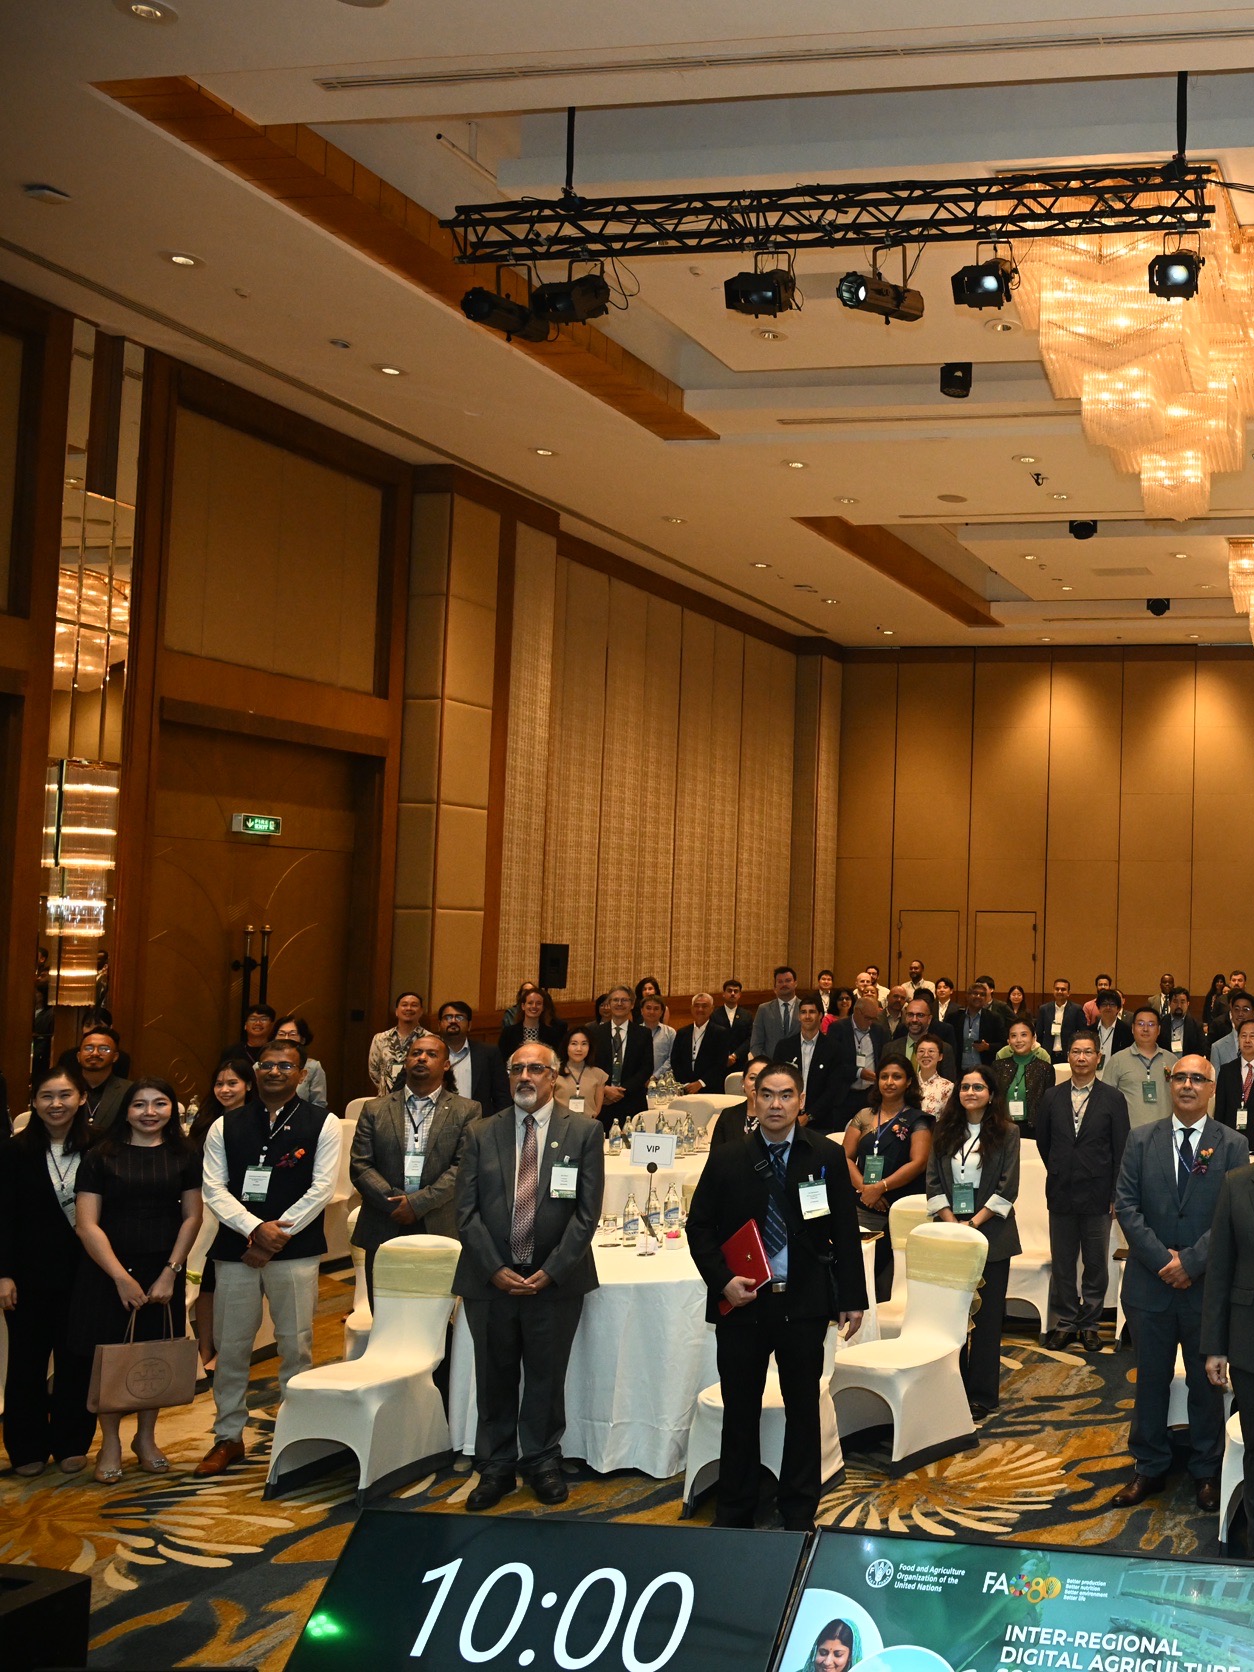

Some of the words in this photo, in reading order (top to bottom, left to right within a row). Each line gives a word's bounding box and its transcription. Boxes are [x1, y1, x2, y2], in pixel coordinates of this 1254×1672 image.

[646, 1145, 660, 1153] VIP
[899, 1563, 915, 1571] Food
[916, 1565, 929, 1573] and
[929, 1566, 965, 1576] Agriculture
[897, 1572, 937, 1582] Organization
[947, 1576, 958, 1584] the
[894, 1581, 915, 1590] United
[917, 1583, 942, 1592] Nations
[409, 1558, 695, 1672] 10:00
[1005, 1625, 1183, 1656] INTER-REGIONAL
[1000, 1646, 1083, 1670] DIGITAL
